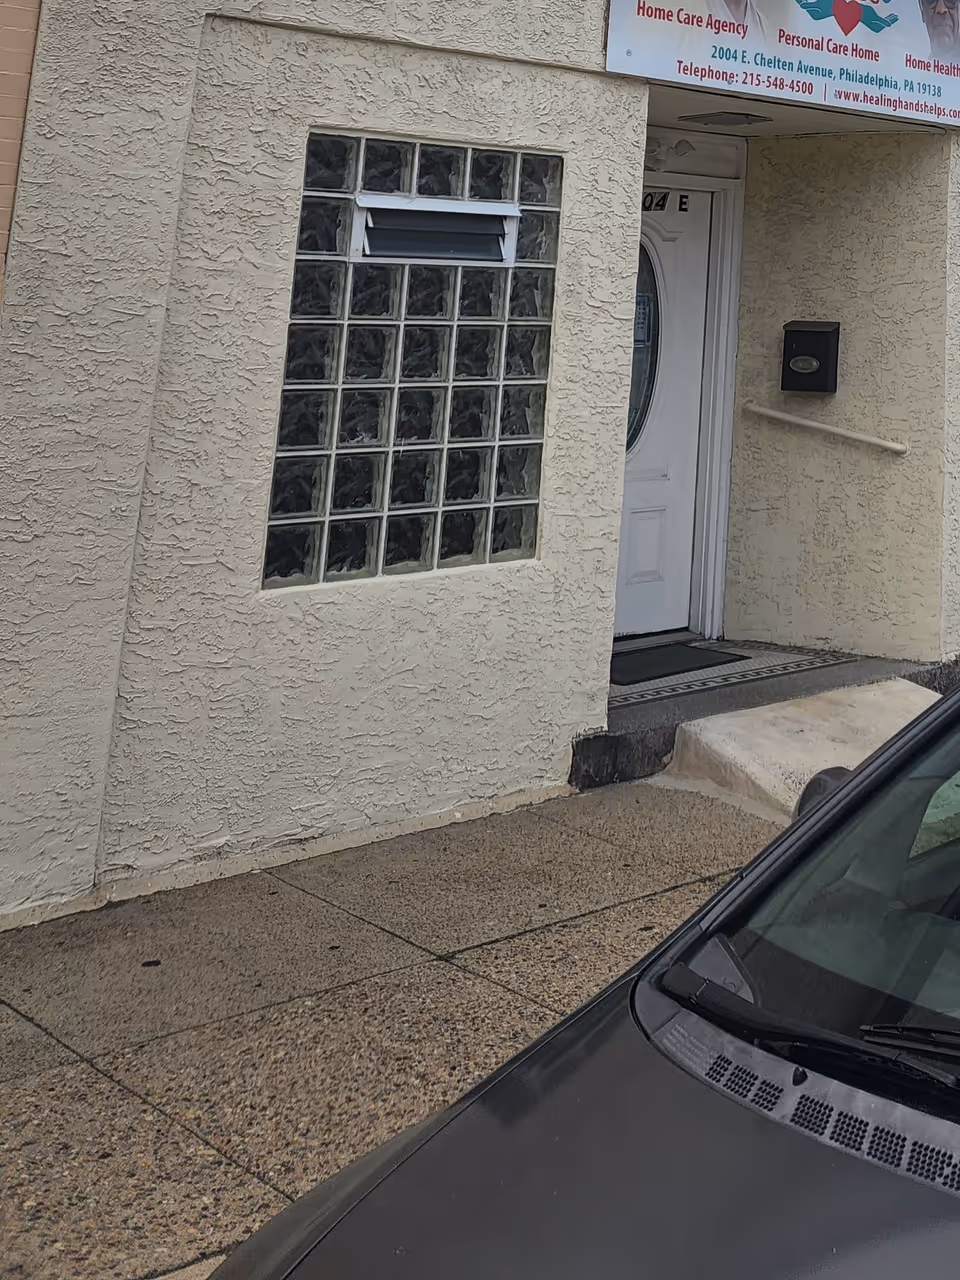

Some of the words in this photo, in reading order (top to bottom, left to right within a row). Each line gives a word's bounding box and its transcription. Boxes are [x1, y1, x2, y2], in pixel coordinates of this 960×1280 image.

[637, 0, 674, 22] Home
[676, 8, 703, 27] Care
[705, 13, 749, 40] Agency
[778, 29, 824, 52] Personal
[826, 38, 849, 57] Care
[850, 43, 880, 62] Home
[677, 60, 739, 83] Telephone:
[741, 71, 814, 95] 215-548-4500
[711, 45, 738, 62] 2004
[741, 50, 751, 65] E.
[753, 53, 794, 72] Chelten
[796, 60, 836, 81] Avenue,
[839, 67, 901, 91] Philadelphia,
[903, 79, 915, 93] PA
[917, 82, 942, 98] 19138
[905, 54, 931, 72] Home
[678, 194, 690, 212] E
